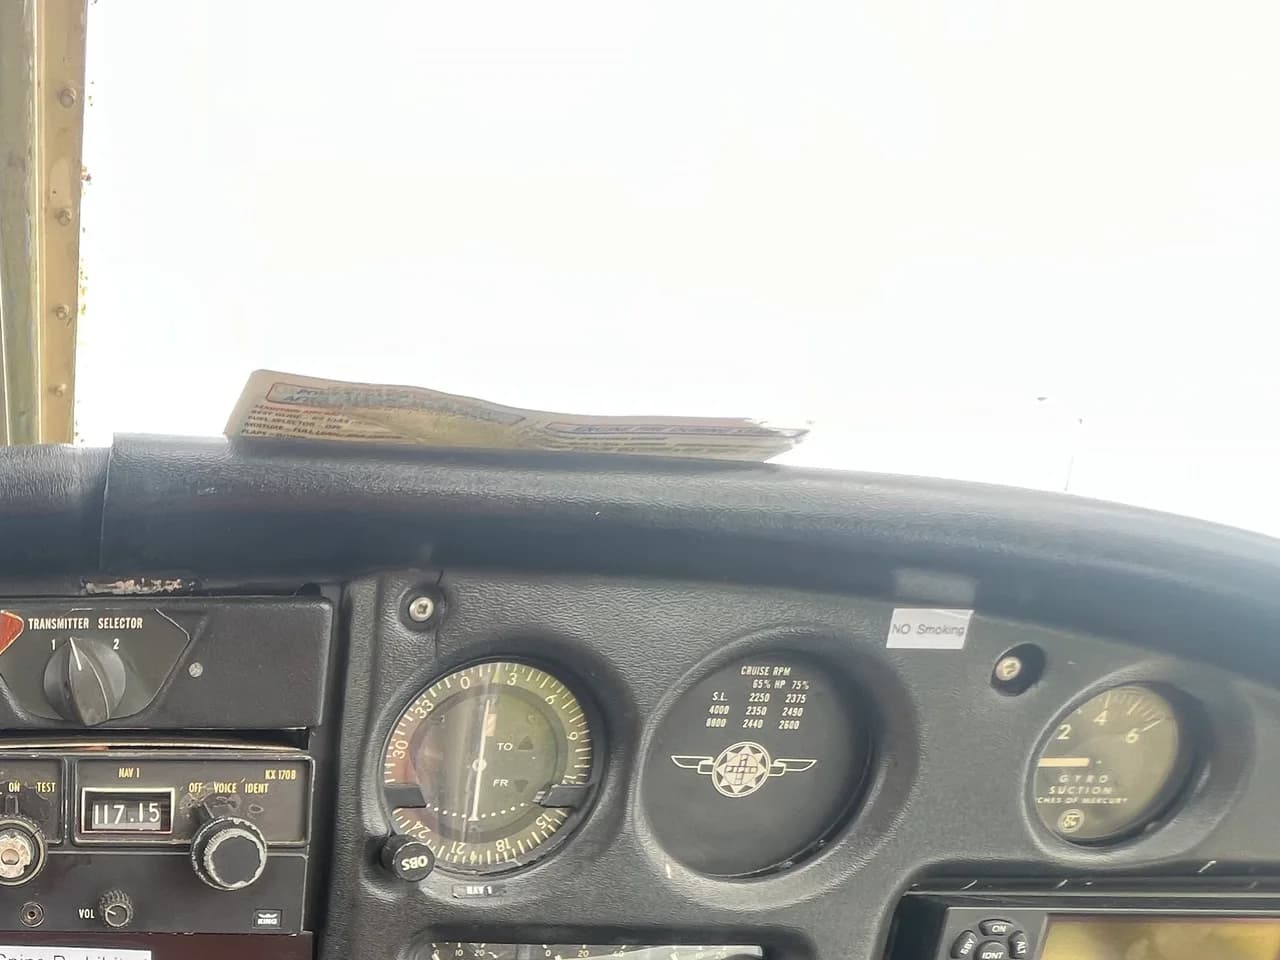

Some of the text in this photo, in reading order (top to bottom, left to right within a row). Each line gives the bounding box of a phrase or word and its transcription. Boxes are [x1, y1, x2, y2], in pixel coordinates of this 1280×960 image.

[28, 618, 143, 629] TRANSMITTER SELECTOR
[892, 624, 964, 636] NO Smoking
[741, 666, 791, 676] CRUISE RPM
[749, 693, 806, 703] 2250 2375
[746, 707, 767, 715] 2350
[743, 719, 763, 728] 2440
[119, 768, 135, 778] NAV
[265, 769, 296, 780] KX 170B
[8, 782, 20, 792] ON
[37, 782, 55, 793] TEST
[188, 782, 269, 793] OFF VOICE IDENT
[93, 803, 160, 823] 117.15
[78, 909, 95, 919] VOL
[982, 952, 1003, 960] IDNT
